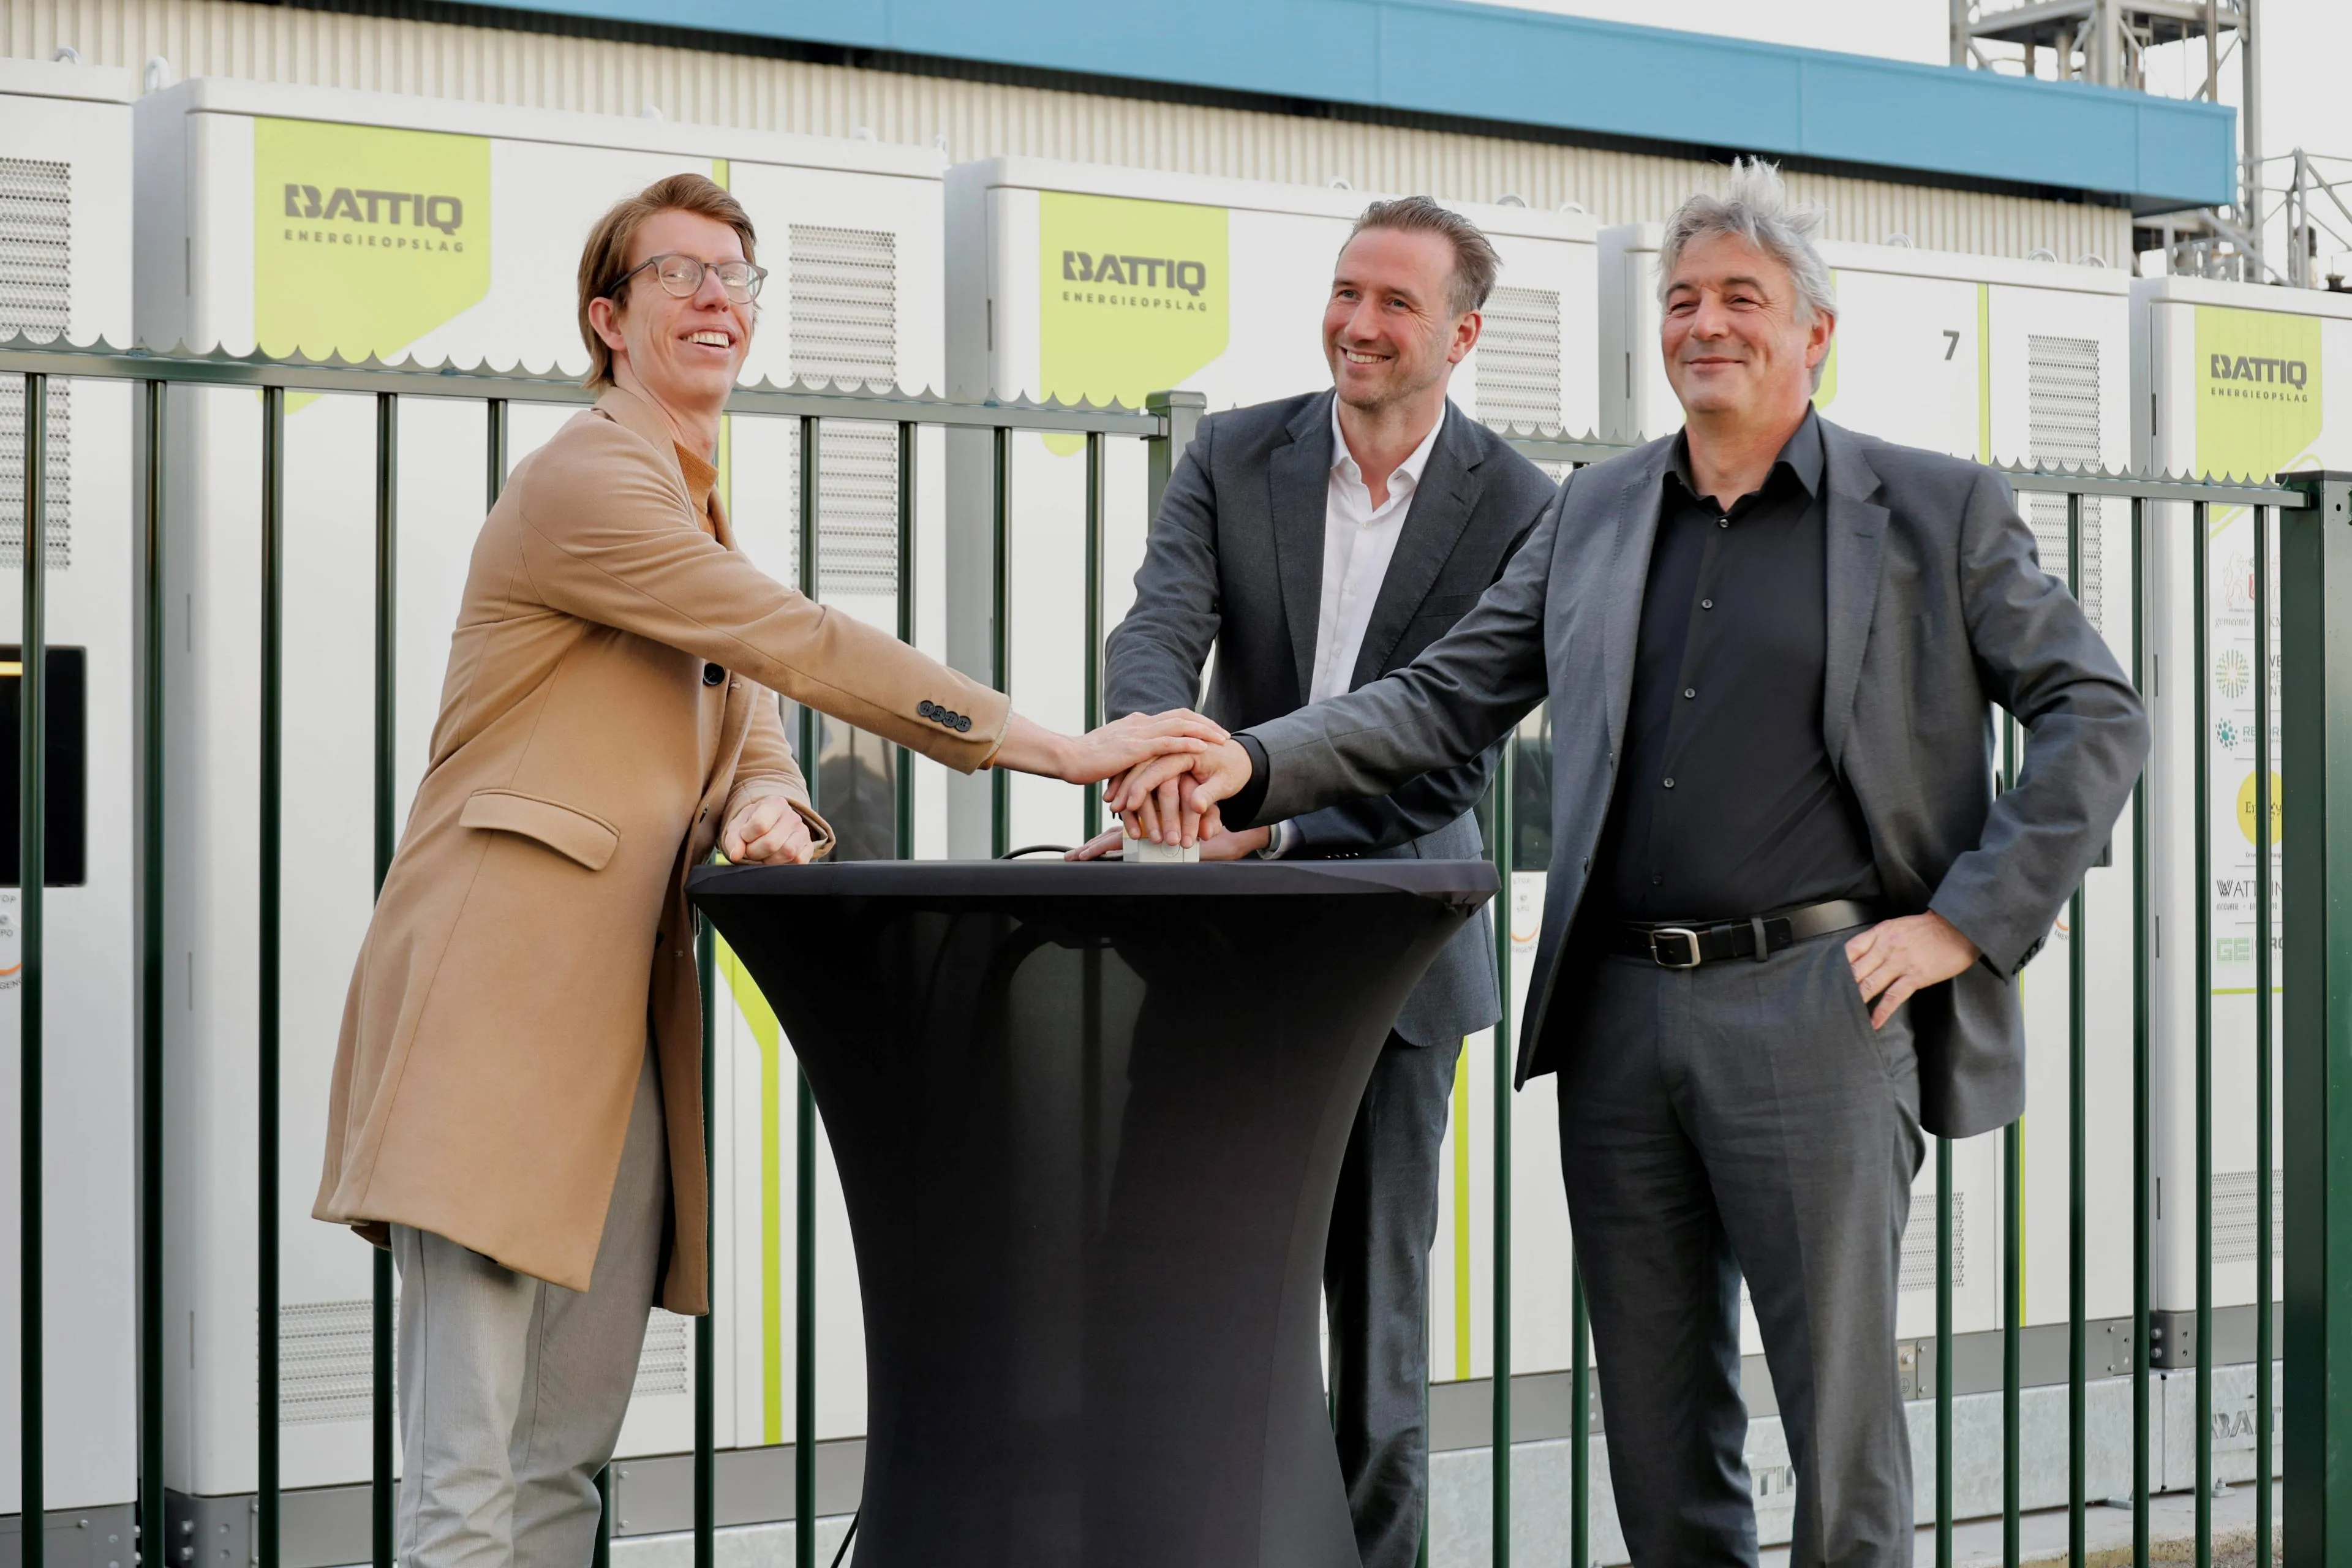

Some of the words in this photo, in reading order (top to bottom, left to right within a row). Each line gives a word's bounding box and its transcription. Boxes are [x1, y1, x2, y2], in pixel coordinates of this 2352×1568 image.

[284, 183, 463, 236] BATTIQ
[284, 230, 464, 252] ENERGIEOPSLAG
[1063, 250, 1205, 296] BATTIQ
[1063, 292, 1207, 311] ENERGIEOPSLAG
[1943, 330, 1960, 360] 7
[2211, 353, 2307, 390] BATTIQ
[2211, 387, 2308, 402] ENERGIEOPSLAG
[2215, 616, 2251, 628] gemeente
[2216, 937, 2250, 962] GE
